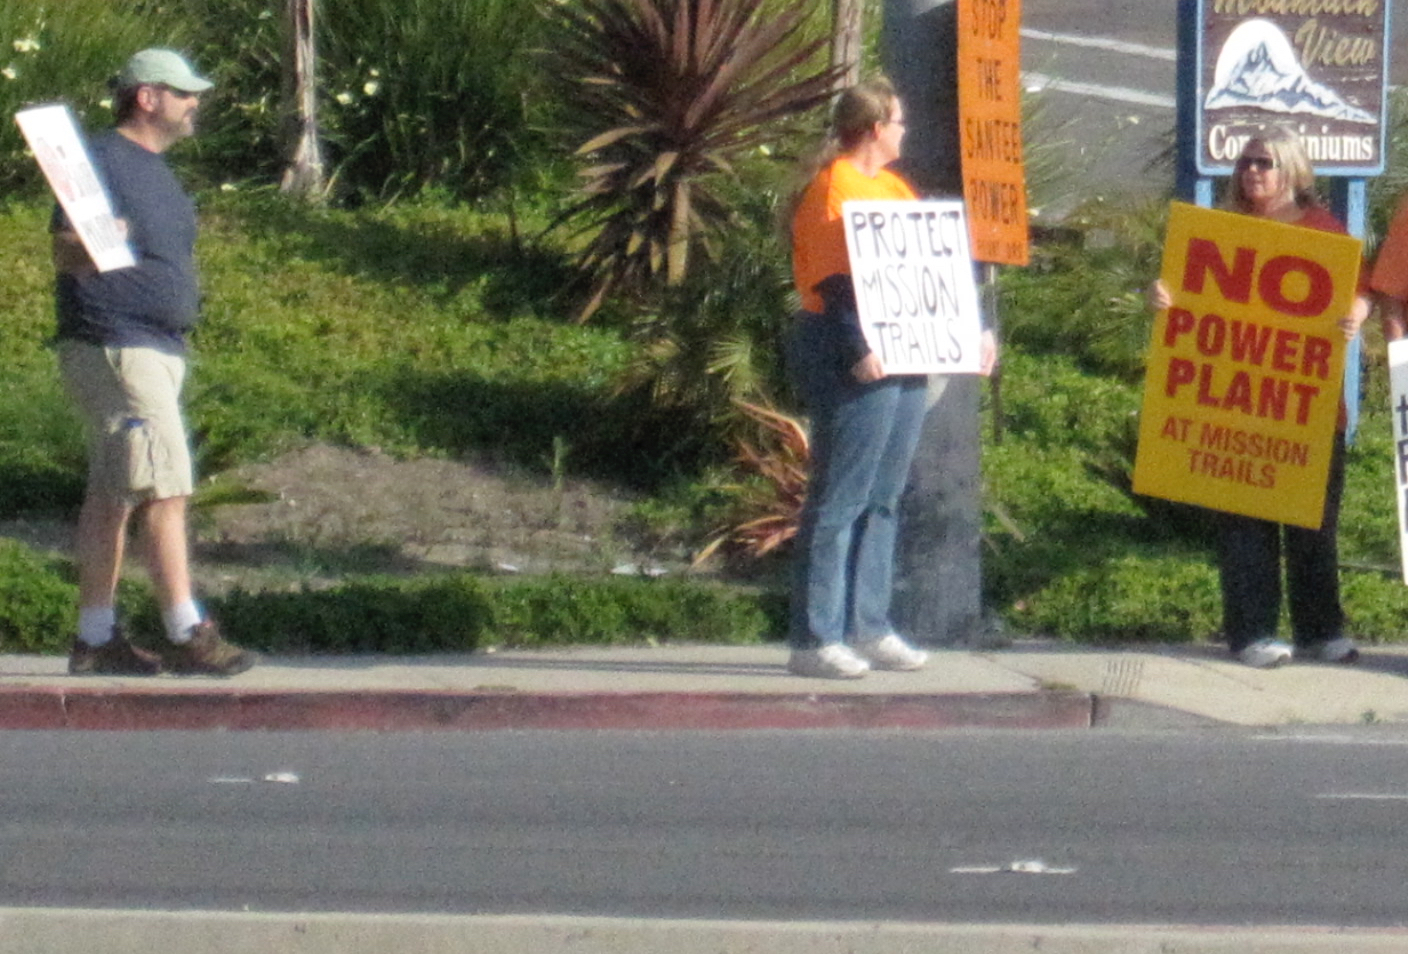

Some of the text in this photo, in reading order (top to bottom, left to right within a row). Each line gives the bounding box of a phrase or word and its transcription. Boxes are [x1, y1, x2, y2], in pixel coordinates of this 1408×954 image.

[1294, 18, 1376, 70] View
[976, 57, 1002, 101] THE
[966, 118, 1019, 164] SANTEE
[970, 179, 1019, 225] POWER
[851, 211, 961, 258] PROTECT
[861, 263, 960, 318] MISSION
[1182, 237, 1334, 318] NO
[872, 318, 962, 364] TRAILS
[1164, 307, 1333, 380] POWER
[1165, 357, 1321, 426] PLANT
[1161, 416, 1309, 467] AT MISSION
[1188, 449, 1277, 490] TRAILS
